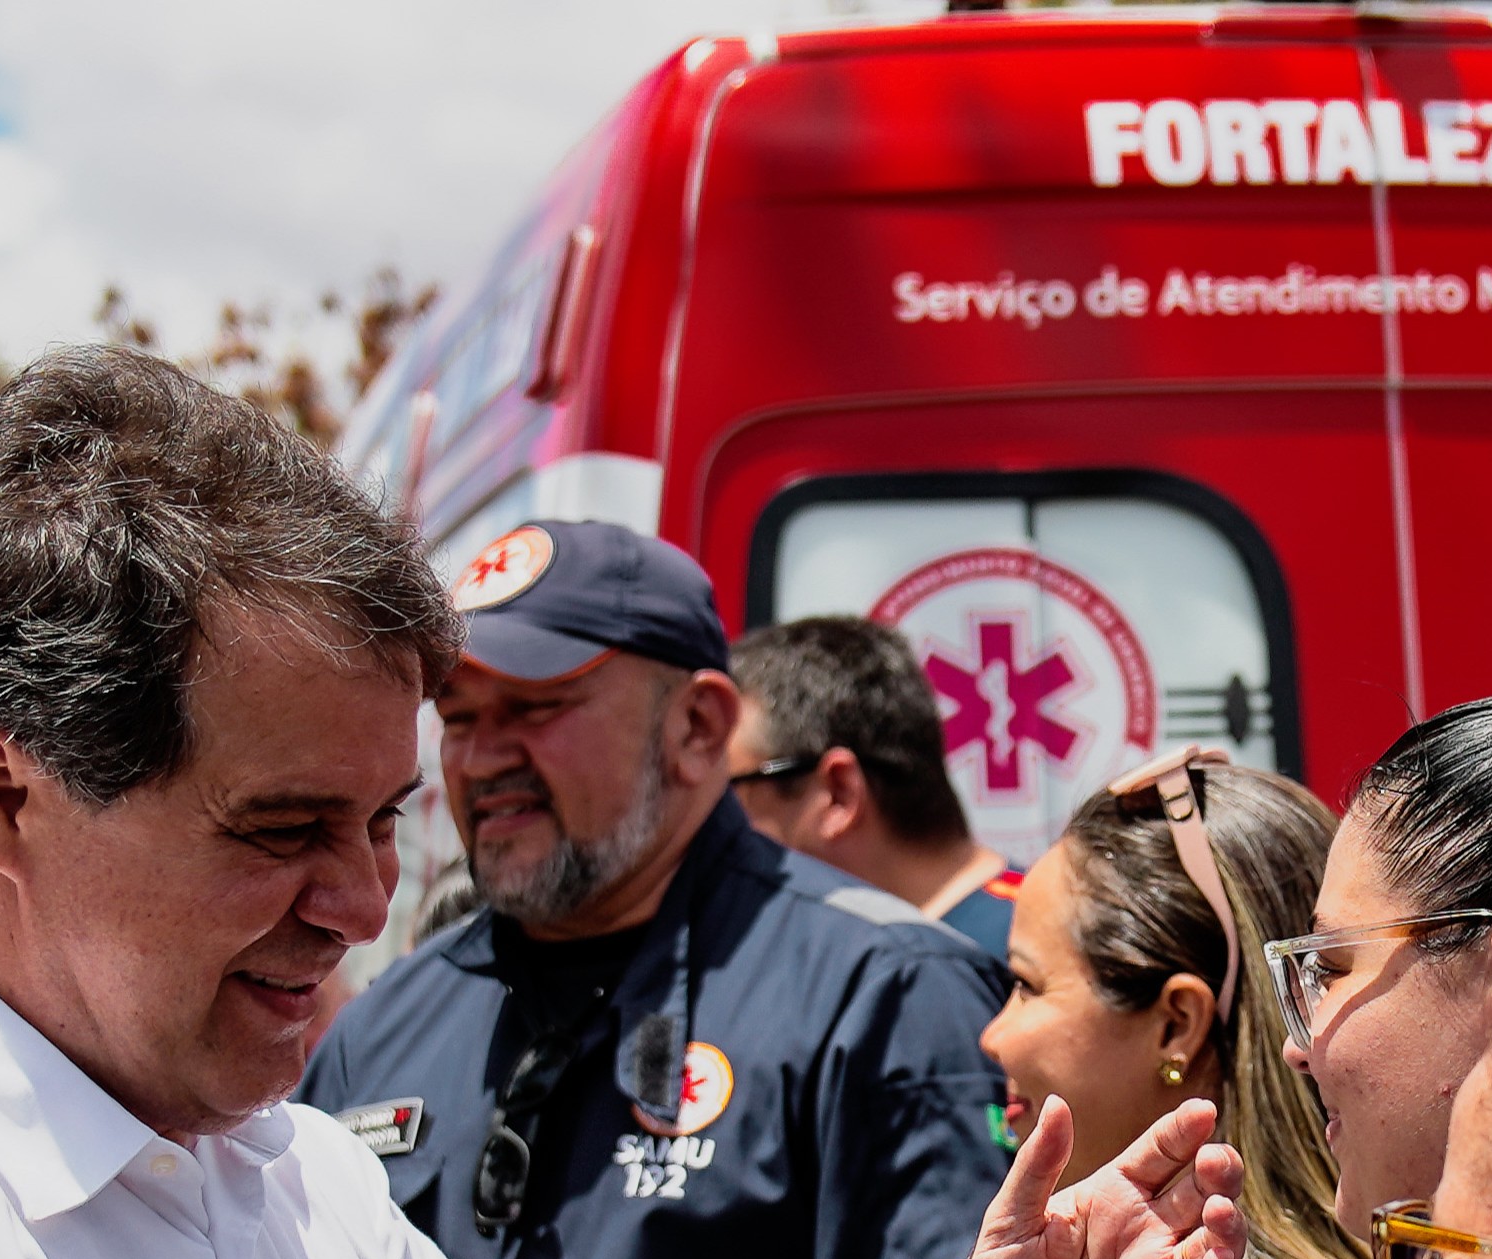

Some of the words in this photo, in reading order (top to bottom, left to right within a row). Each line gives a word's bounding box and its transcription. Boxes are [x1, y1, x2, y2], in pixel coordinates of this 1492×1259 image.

[892, 270, 1077, 330] Serviço
[1082, 264, 1150, 318] de
[1159, 262, 1470, 316] Atendimento
[613, 1133, 717, 1170] SAMU
[623, 1162, 688, 1199] 192
